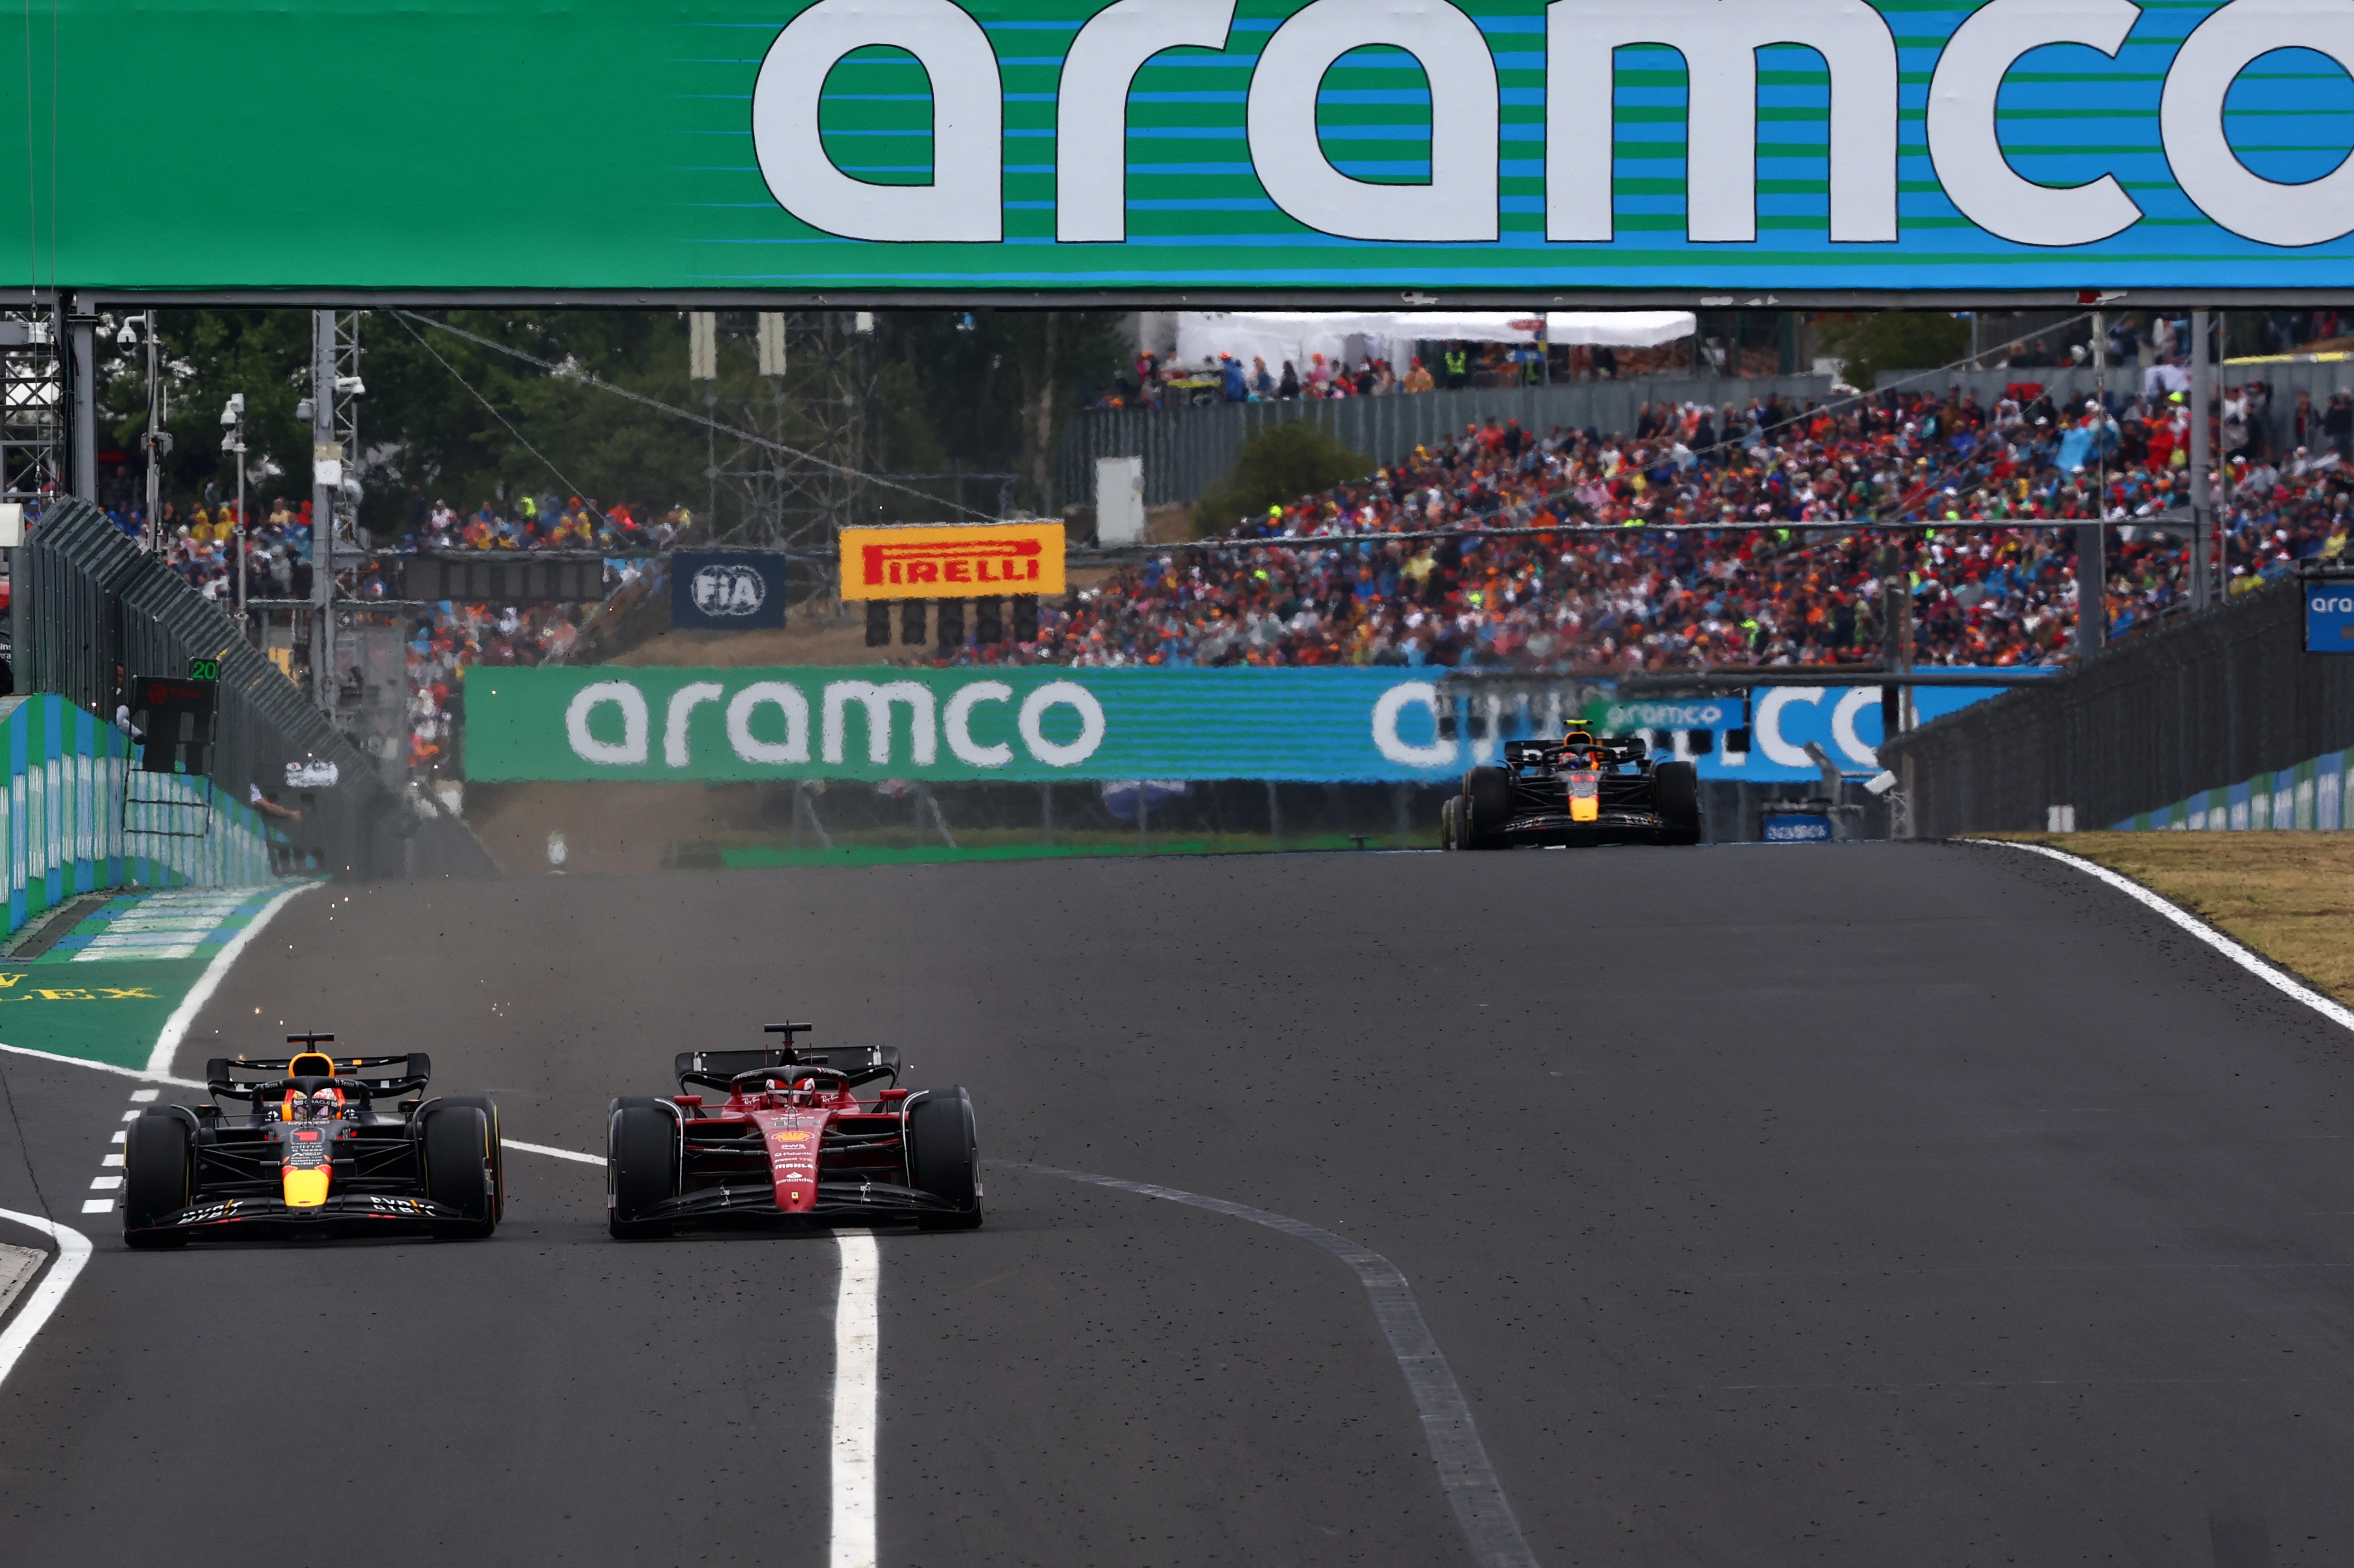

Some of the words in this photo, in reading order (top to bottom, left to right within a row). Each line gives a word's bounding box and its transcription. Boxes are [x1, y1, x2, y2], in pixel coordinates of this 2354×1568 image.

[751, 0, 2354, 247] aramco
[863, 539, 1041, 587] PIRELLI
[192, 661, 217, 680] 20
[566, 680, 1106, 768] aramco
[1606, 705, 1722, 725] aramco
[741, 1096, 761, 1105] Ray-Ban
[820, 1094, 839, 1103] Ray-Ban
[294, 1131, 319, 1141] 1
